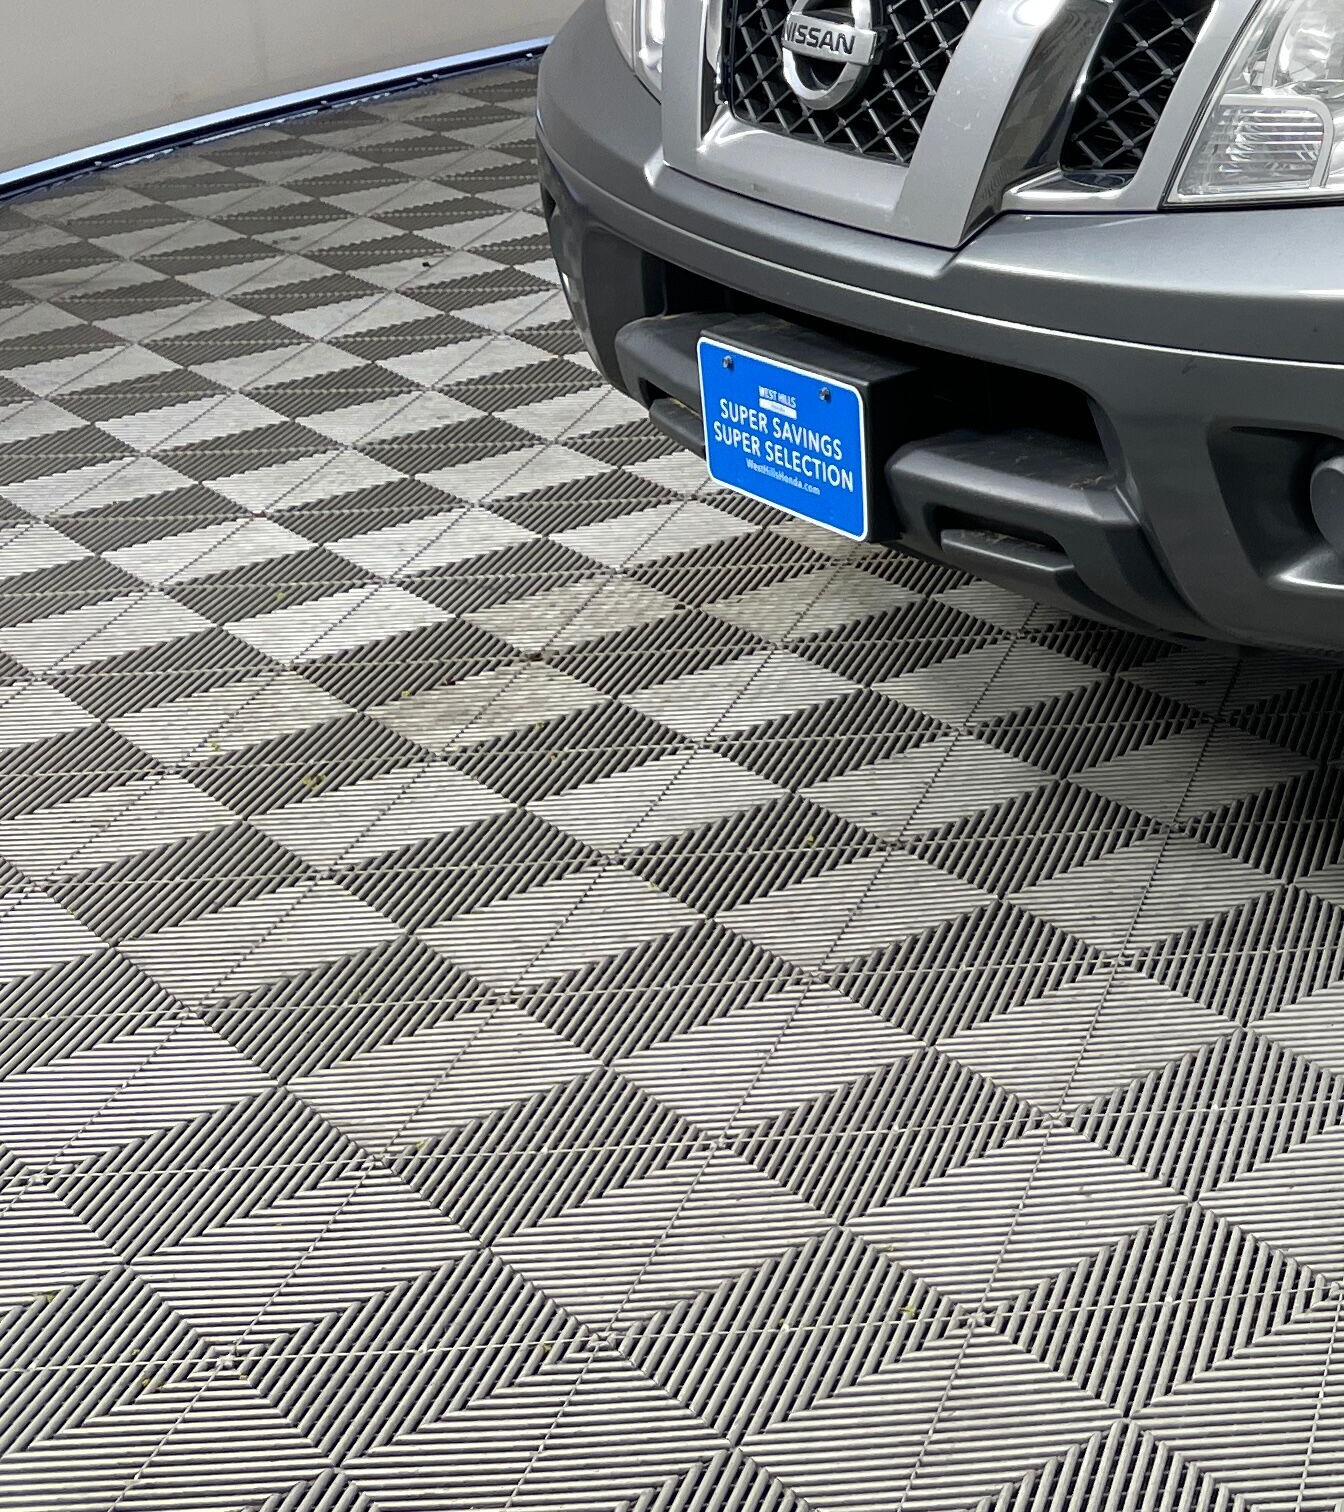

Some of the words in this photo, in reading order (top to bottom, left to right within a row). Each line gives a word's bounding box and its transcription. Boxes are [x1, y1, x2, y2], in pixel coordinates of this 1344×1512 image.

[785, 21, 856, 55] NISSAN
[713, 421, 761, 457] SUPER
[764, 441, 854, 493] SELECTION
[719, 398, 768, 435] SUPER
[772, 417, 844, 461] SAVINGS
